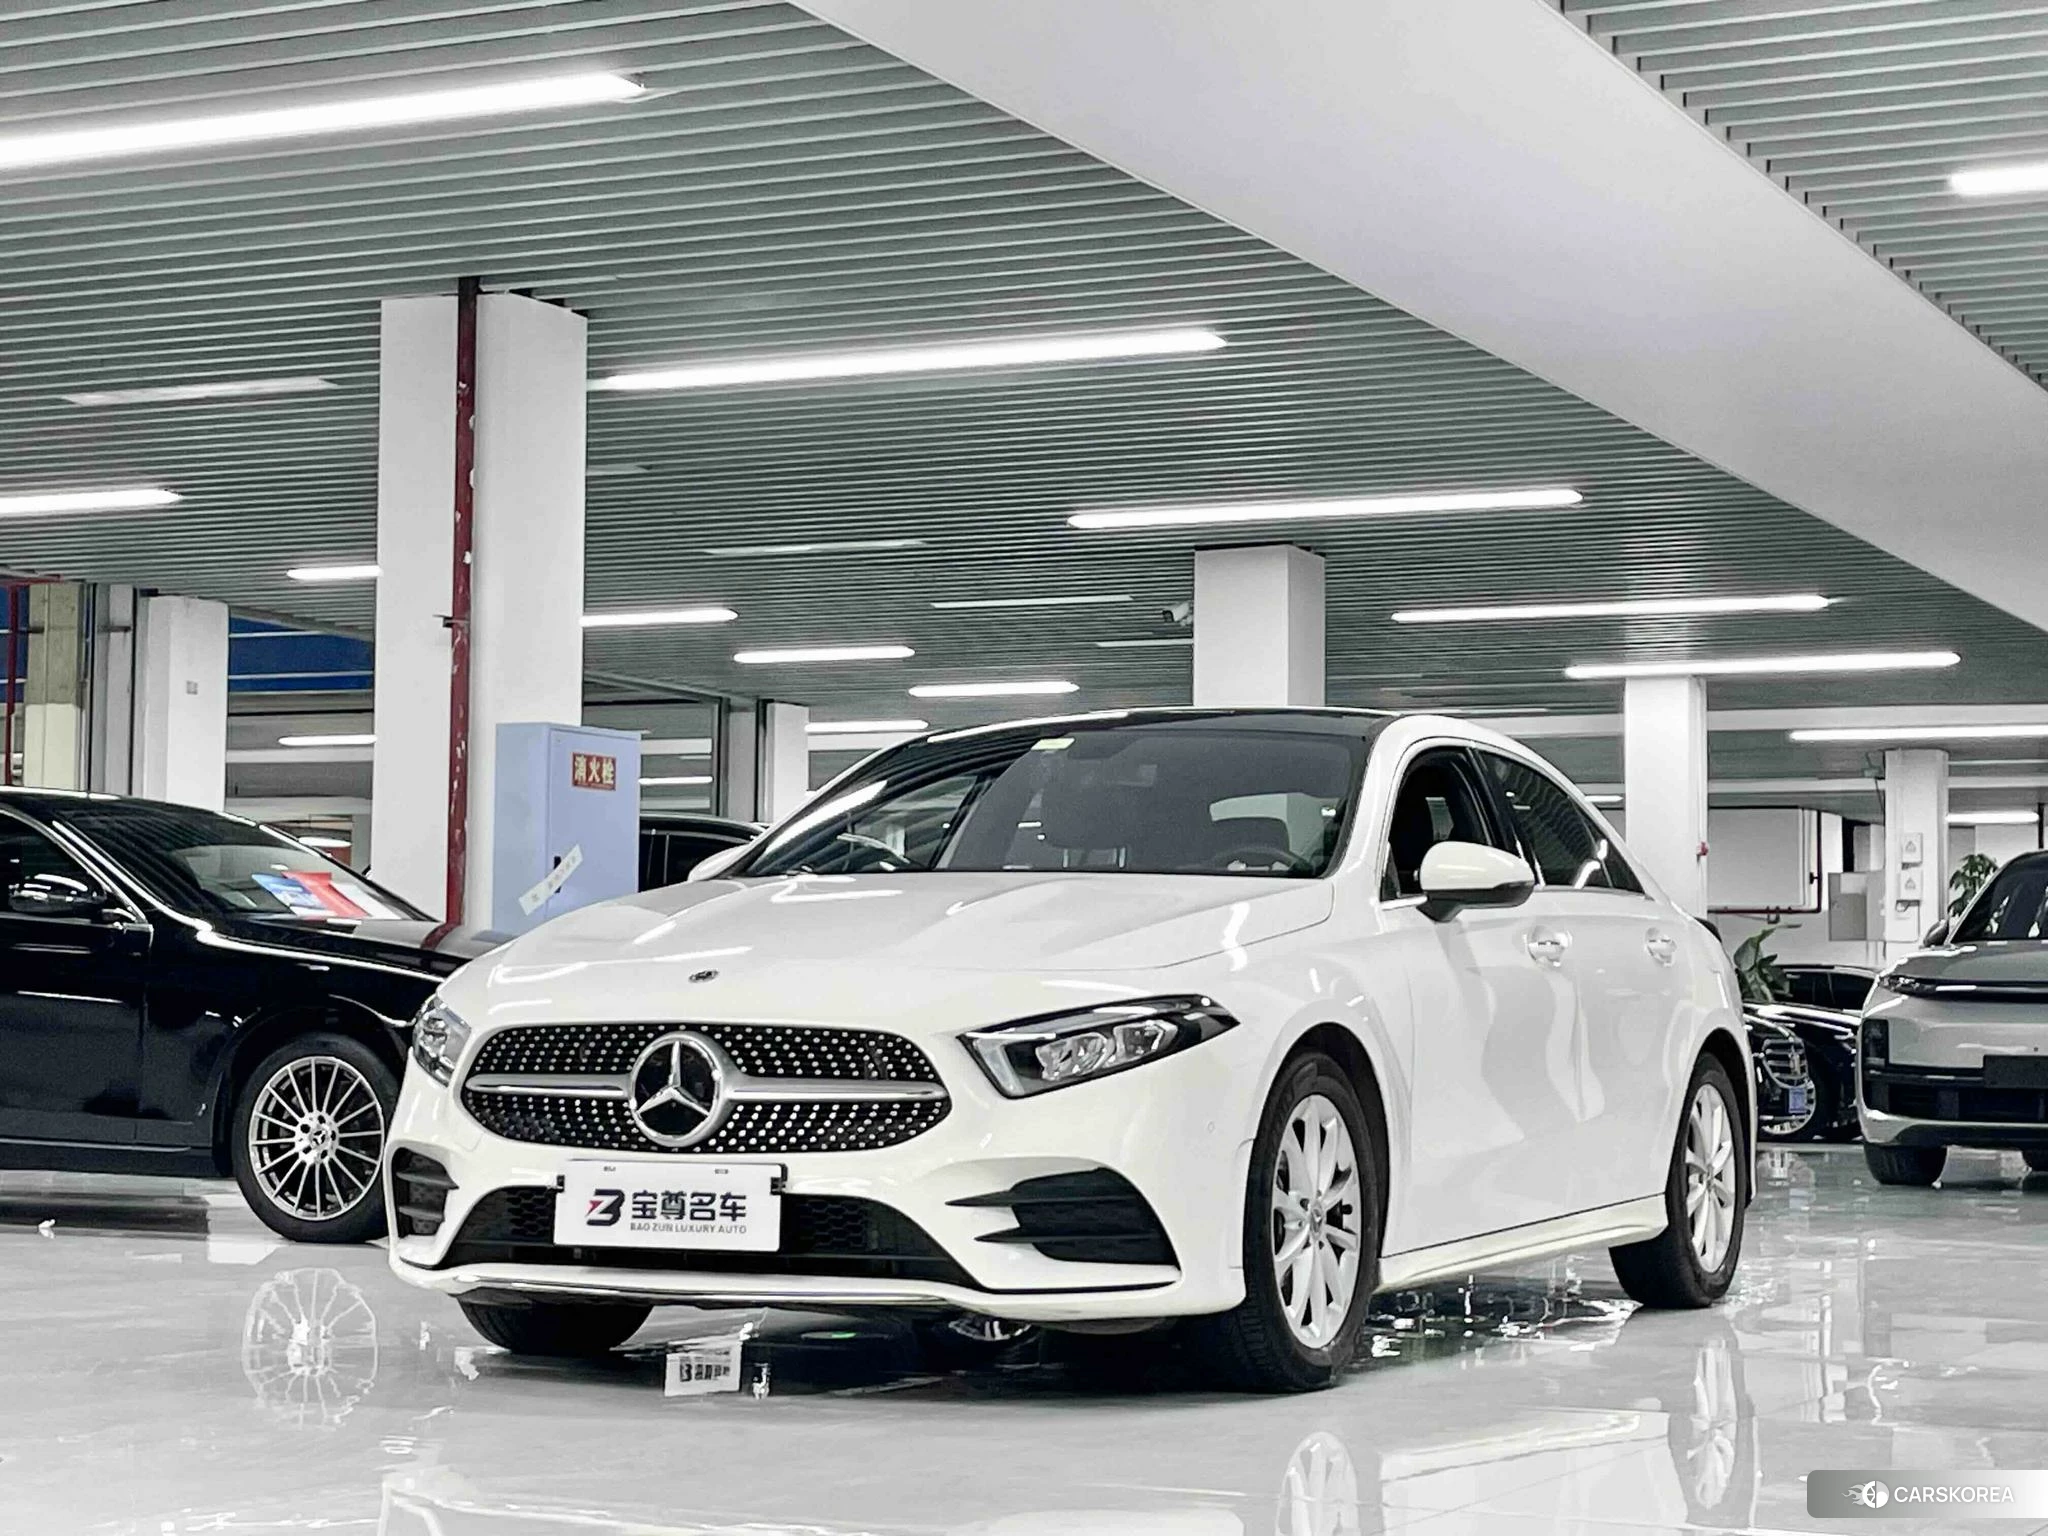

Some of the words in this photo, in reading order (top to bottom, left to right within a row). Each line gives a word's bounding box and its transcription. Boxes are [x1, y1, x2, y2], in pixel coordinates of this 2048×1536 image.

[632, 1190, 747, 1222] 宝尊名车
[630, 1222, 651, 1232] BAO
[652, 1222, 674, 1233] ZUN
[675, 1223, 715, 1234] LUXURY
[718, 1224, 747, 1234] AUTO
